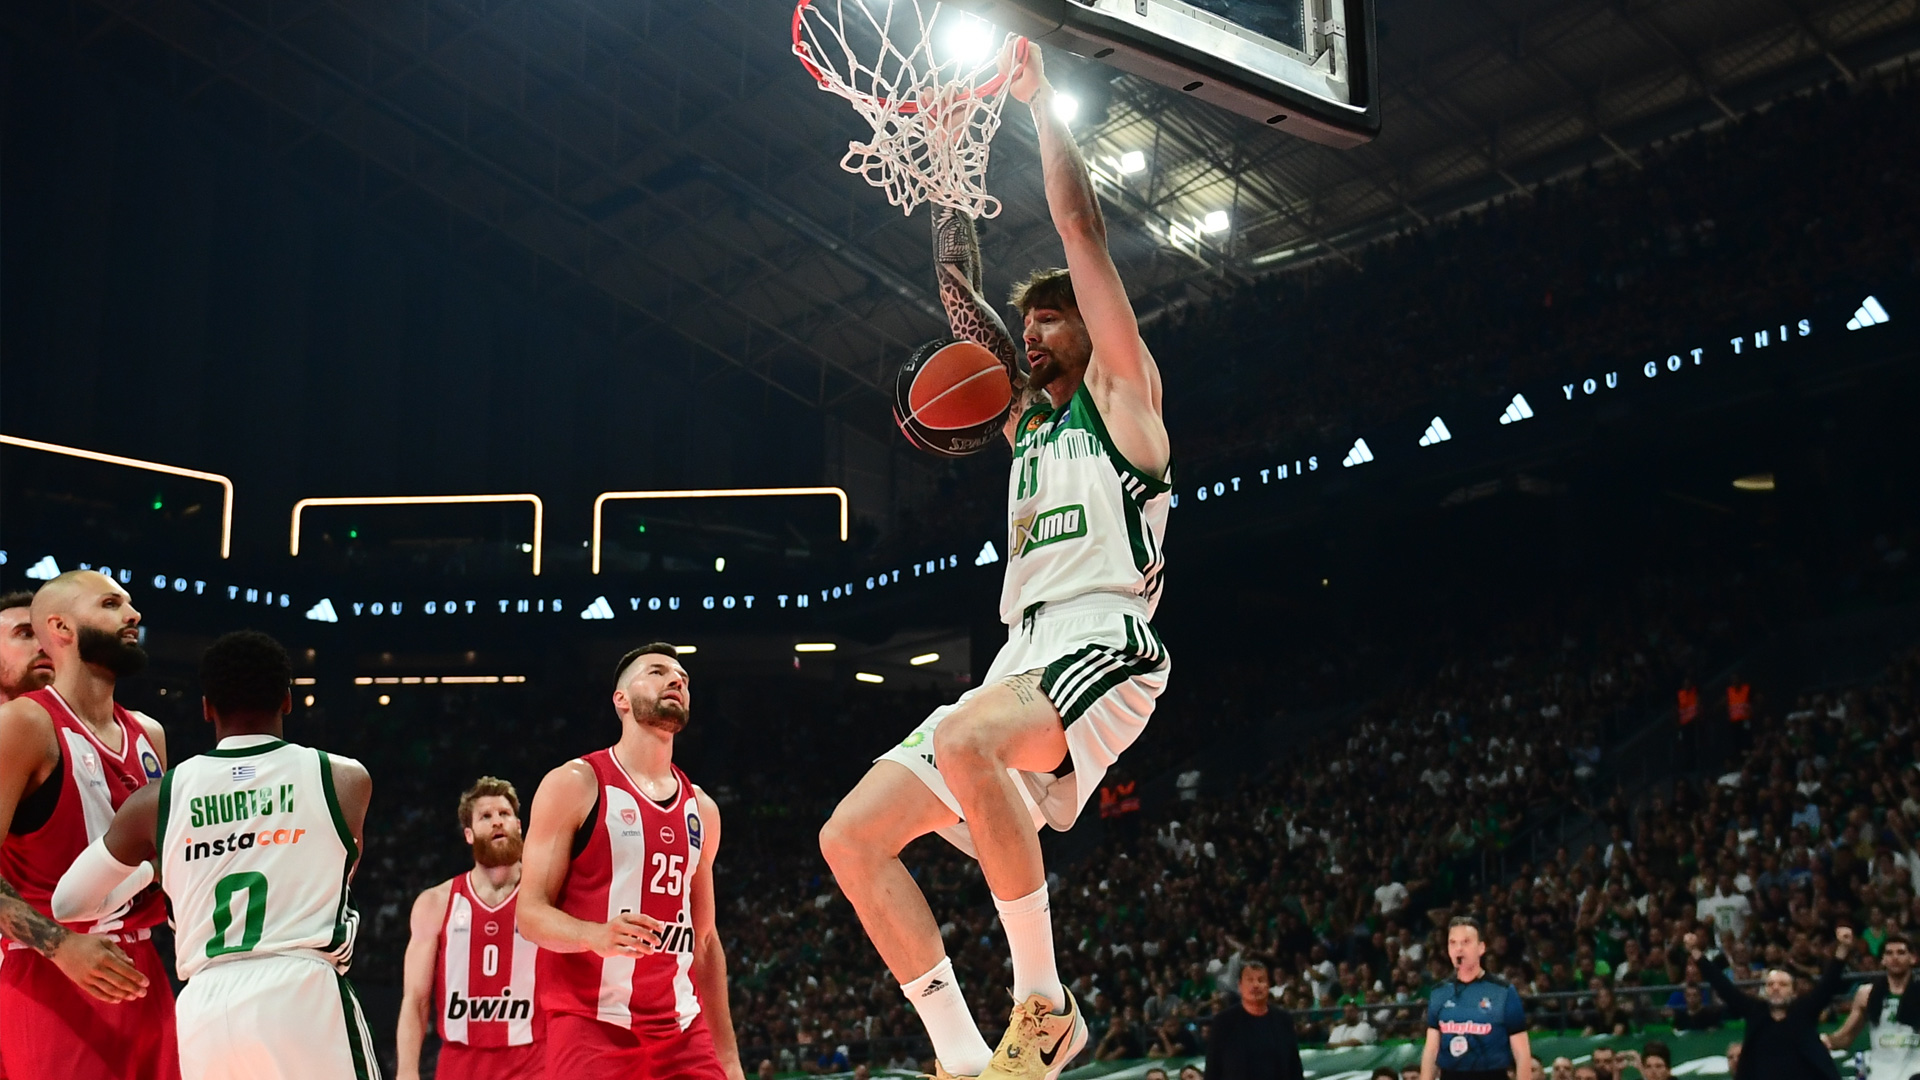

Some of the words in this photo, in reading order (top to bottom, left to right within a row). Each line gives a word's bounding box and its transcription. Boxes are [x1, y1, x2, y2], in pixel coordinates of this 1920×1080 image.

[1562, 371, 1618, 401] YOU
[1643, 346, 1704, 378] GOT
[1730, 318, 1811, 355] THIS
[1196, 481, 1241, 501] GOT
[1259, 455, 1319, 484] THIS
[153, 574, 207, 597] GOT
[227, 586, 290, 608] THIS
[821, 582, 853, 602] YOU
[865, 569, 900, 590] GOT
[913, 554, 958, 578] THIS
[352, 602, 403, 616] YOU
[424, 600, 478, 615] GOT
[498, 599, 563, 614] THIS
[629, 597, 681, 611] YOU
[702, 596, 755, 611] GOT
[184, 828, 306, 862] instacar
[650, 852, 684, 896] 25
[205, 871, 268, 958] 0
[482, 943, 499, 976] 0
[447, 989, 531, 1020] bwin
